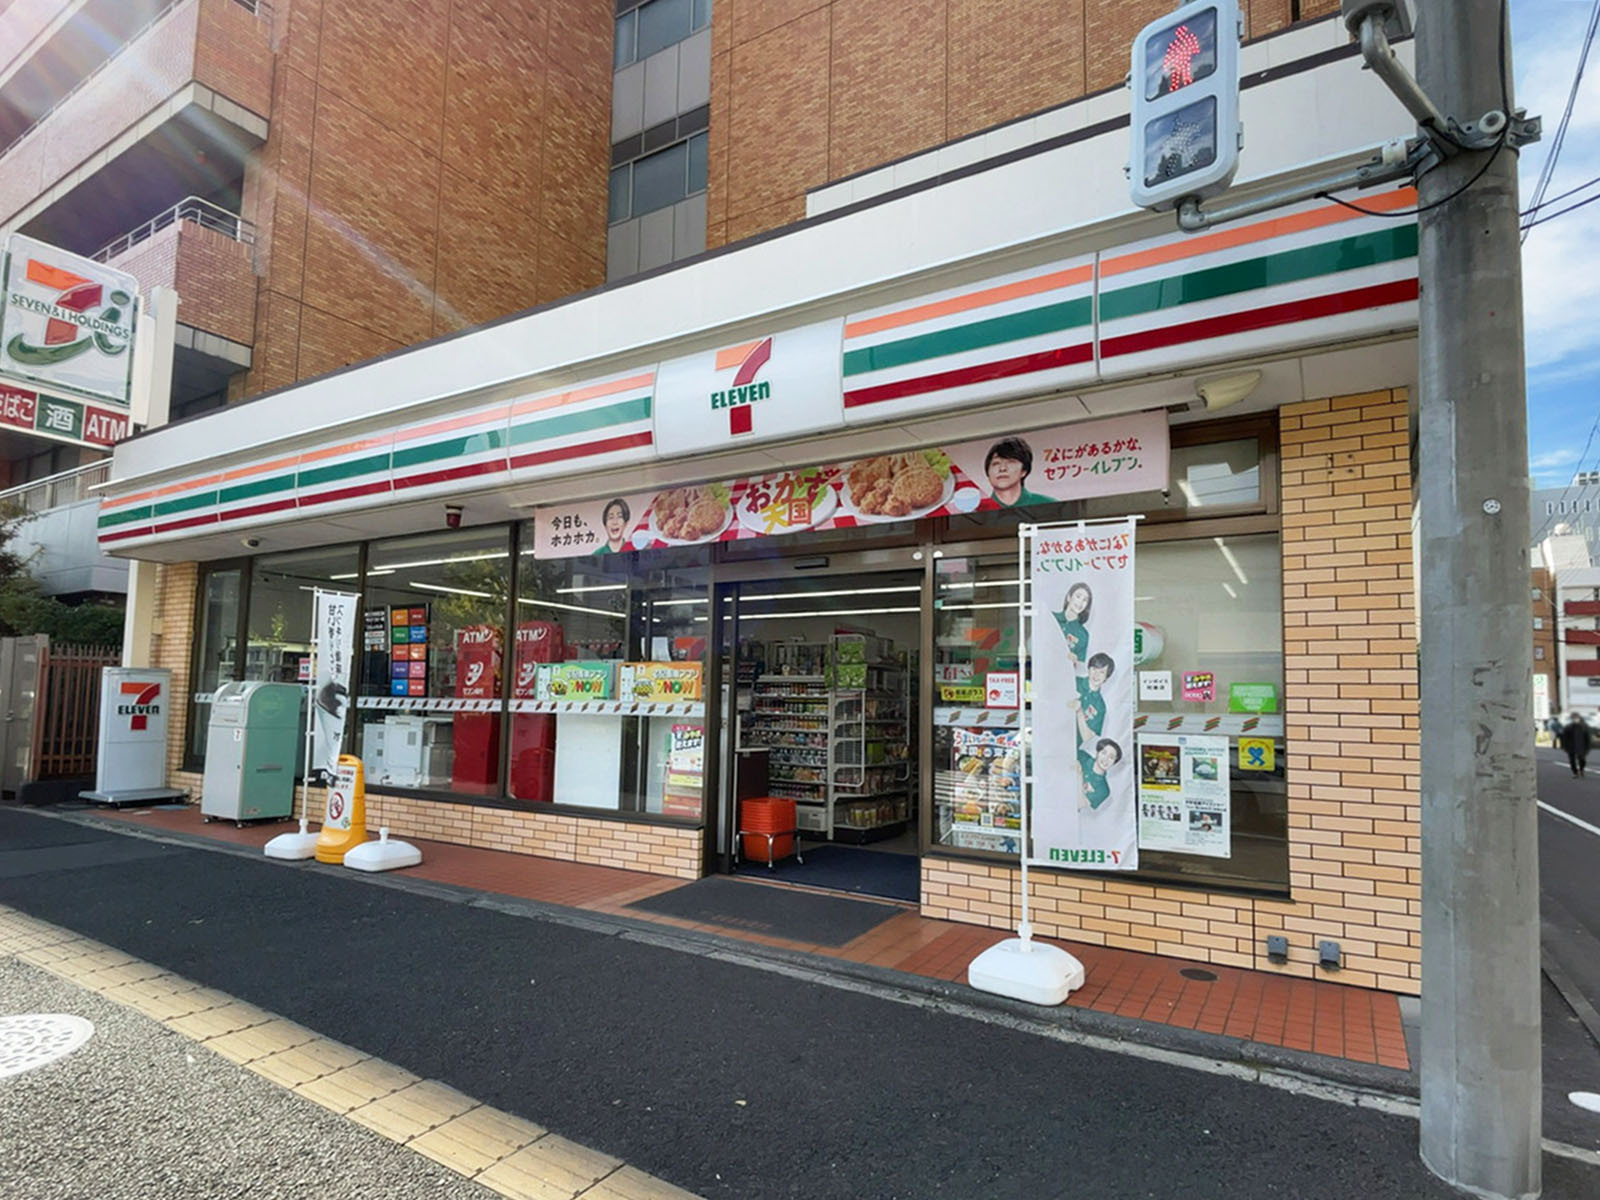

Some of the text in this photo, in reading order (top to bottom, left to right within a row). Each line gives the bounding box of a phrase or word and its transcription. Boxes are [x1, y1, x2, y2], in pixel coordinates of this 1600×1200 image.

[69, 312, 130, 340] HOLDINGS
[45, 403, 76, 432] 酒
[86, 413, 126, 441] ATM
[746, 468, 841, 513] おかず
[760, 497, 812, 534] 天国
[463, 631, 485, 643] ATM
